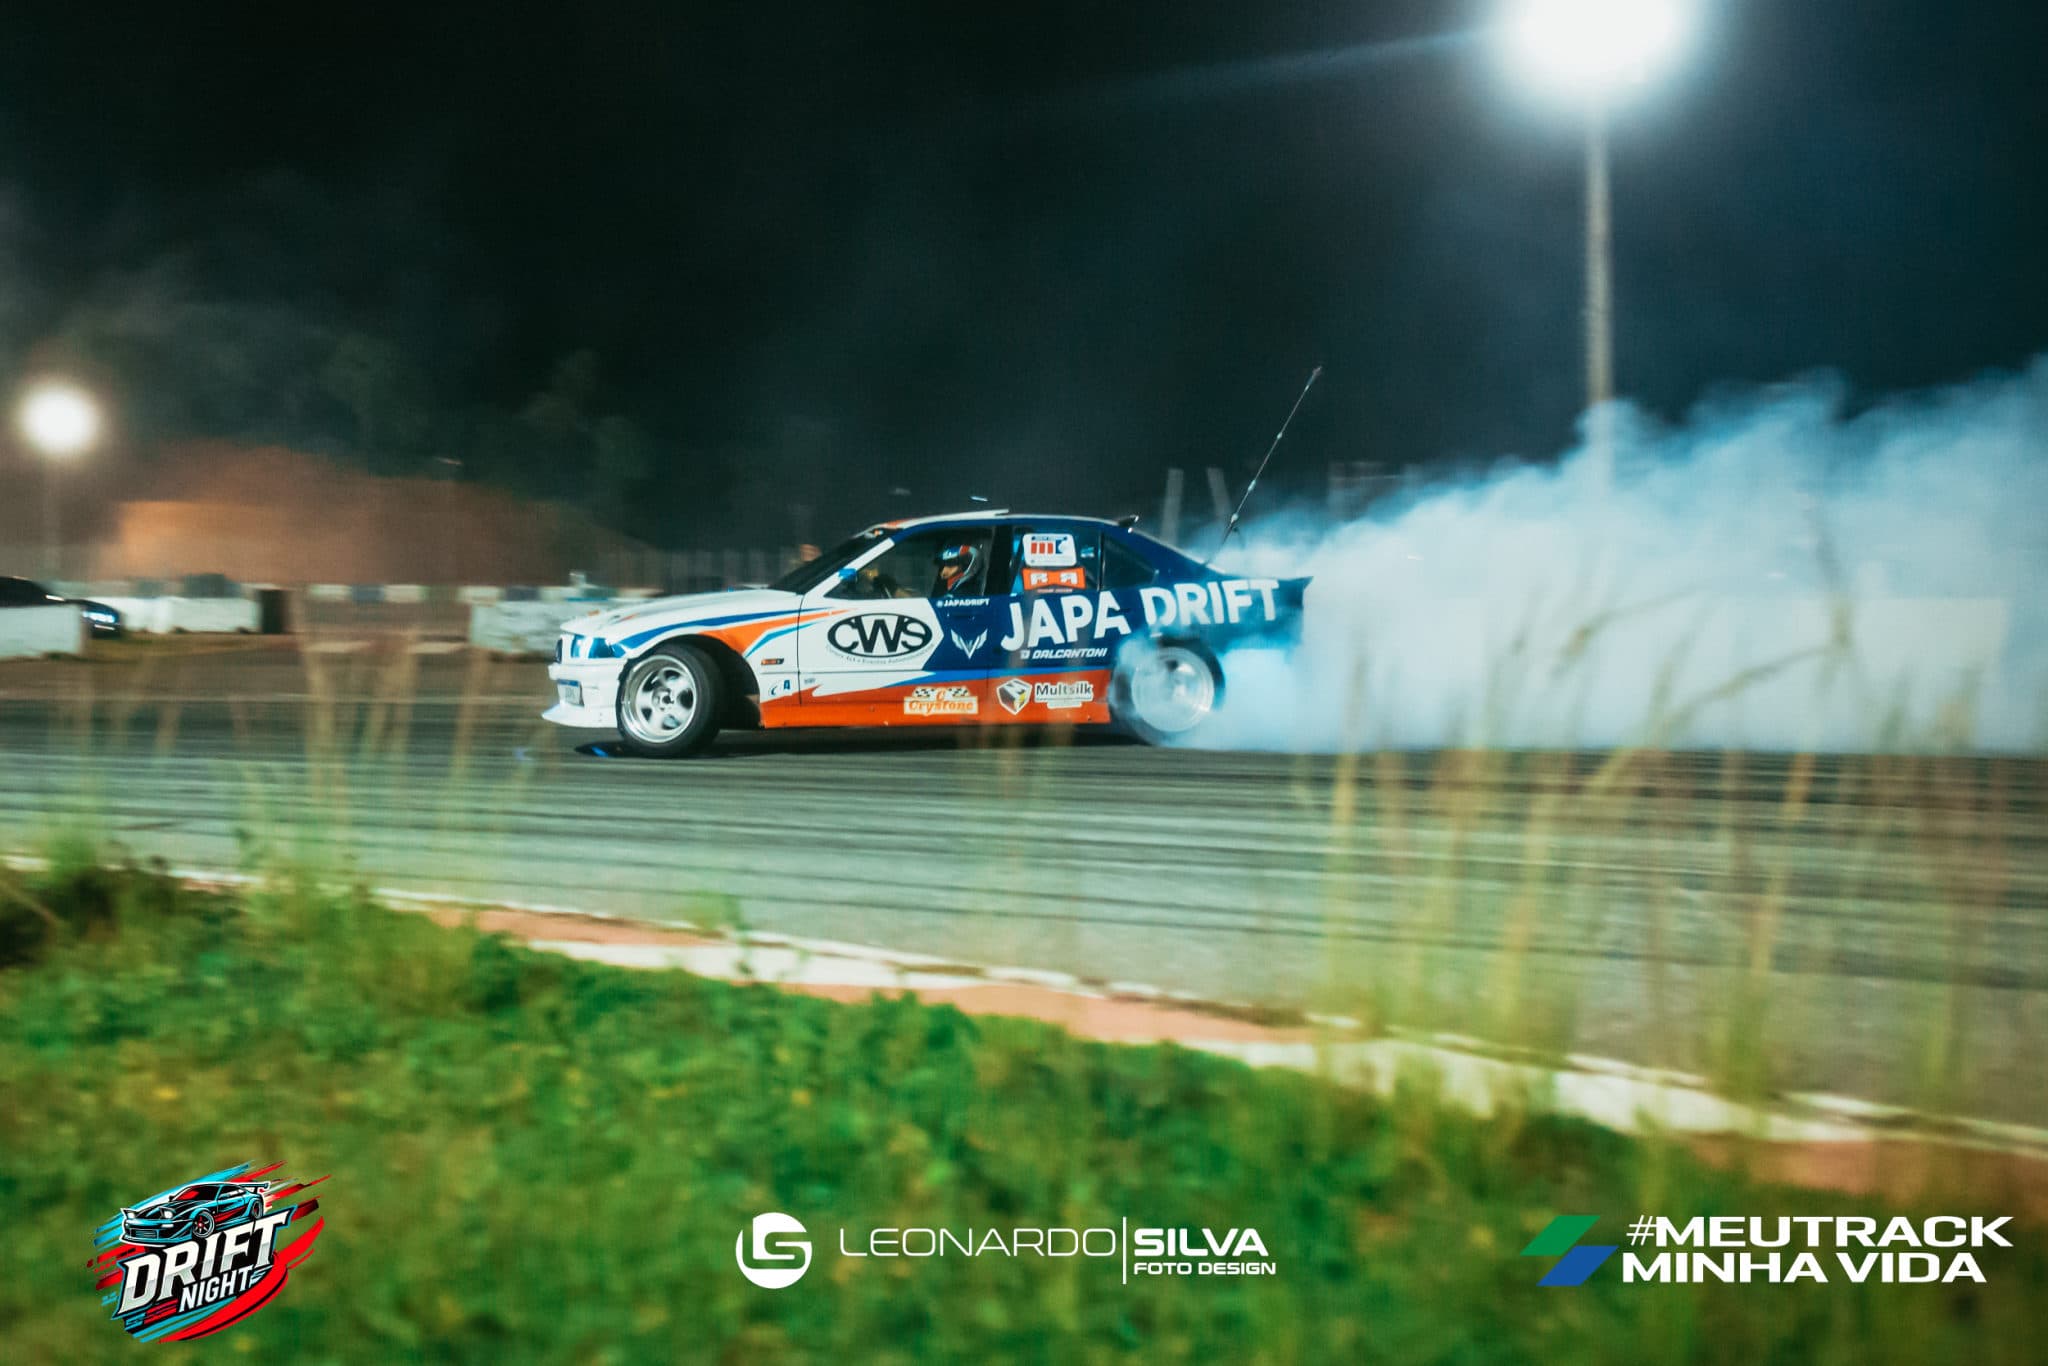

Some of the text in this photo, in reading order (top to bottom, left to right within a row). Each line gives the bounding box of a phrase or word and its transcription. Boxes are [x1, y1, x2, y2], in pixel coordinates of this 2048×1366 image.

[944, 598, 990, 607] JAPADRIFT
[1001, 580, 1279, 650] JAPA DRIFT
[828, 614, 933, 657] CWS
[1032, 648, 1107, 660] DALCANTONI
[1036, 683, 1092, 696] Multsilk
